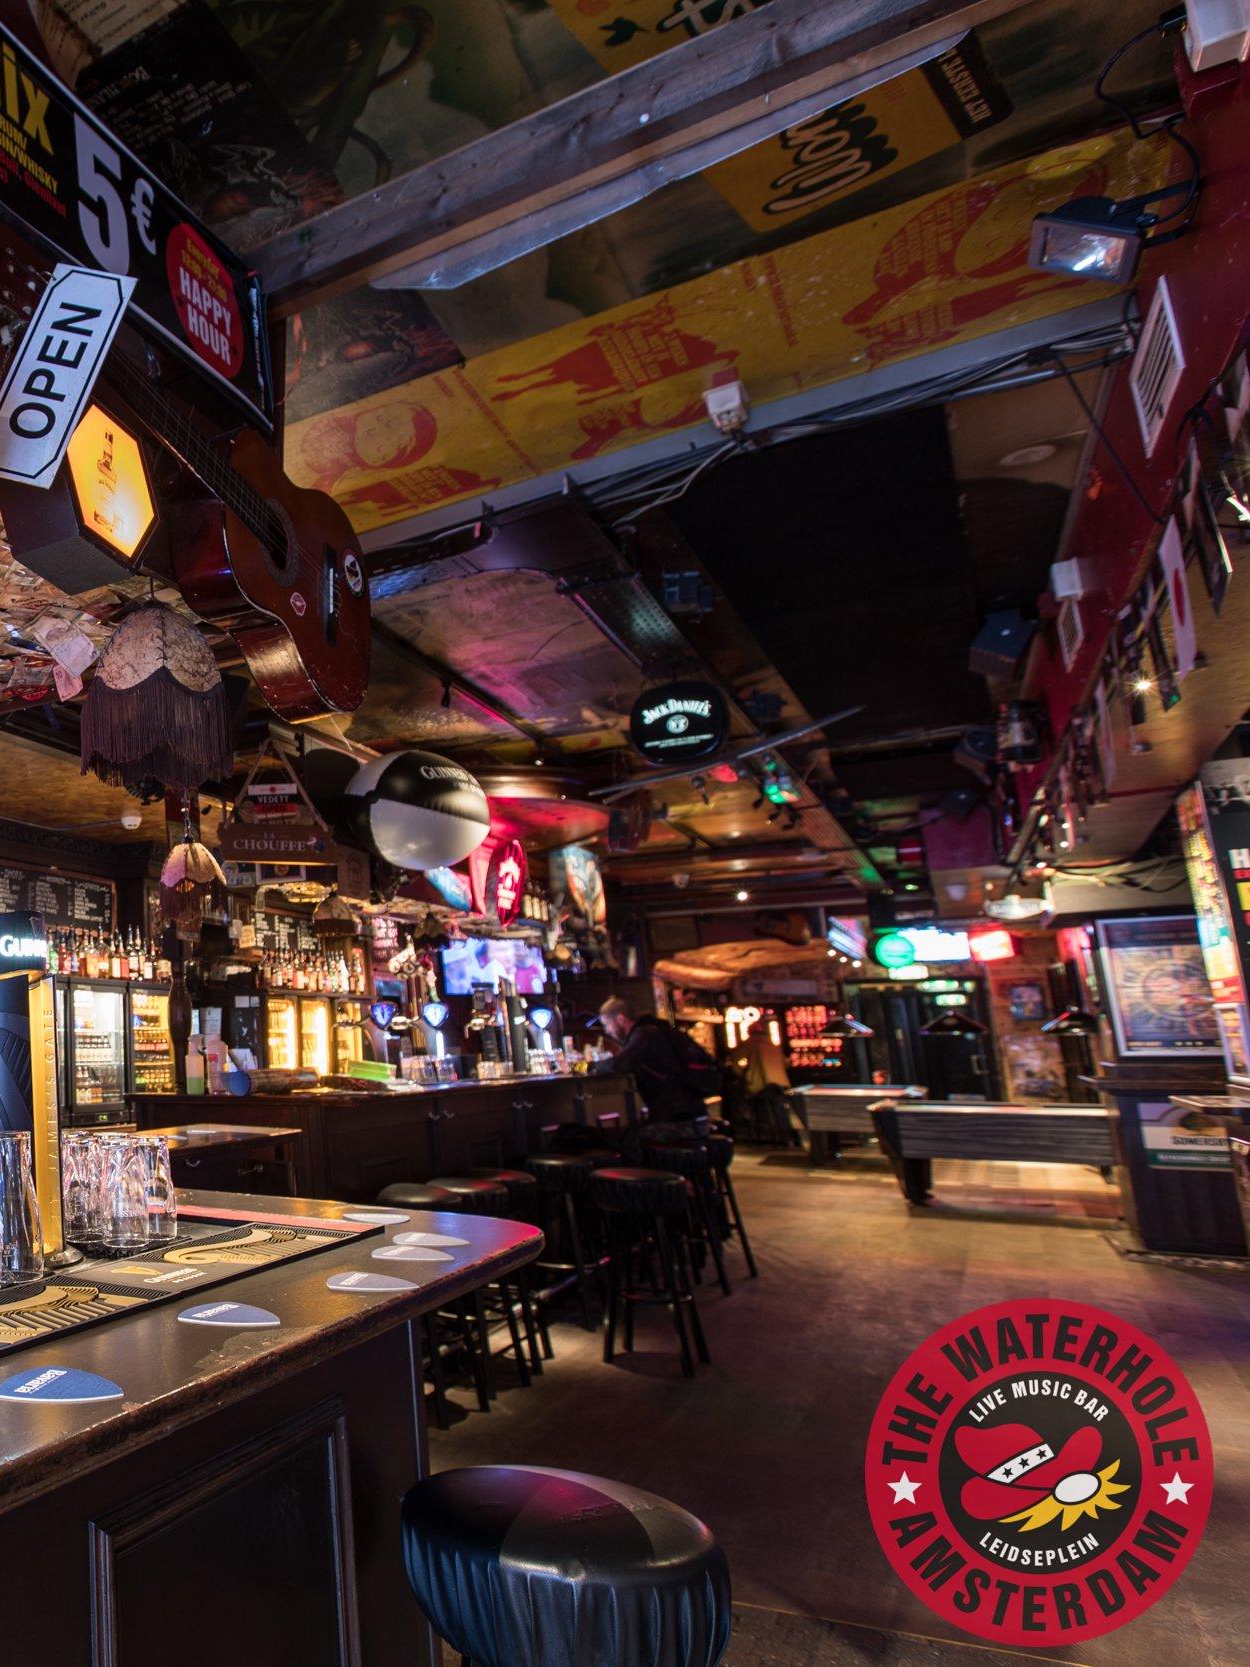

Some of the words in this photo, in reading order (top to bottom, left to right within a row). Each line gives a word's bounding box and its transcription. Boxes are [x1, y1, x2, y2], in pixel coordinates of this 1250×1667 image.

[179, 267, 232, 336] HAPPY
[187, 309, 231, 366] HOUR
[9, 300, 103, 440] OPEN
[233, 838, 307, 852] CHOUFFE
